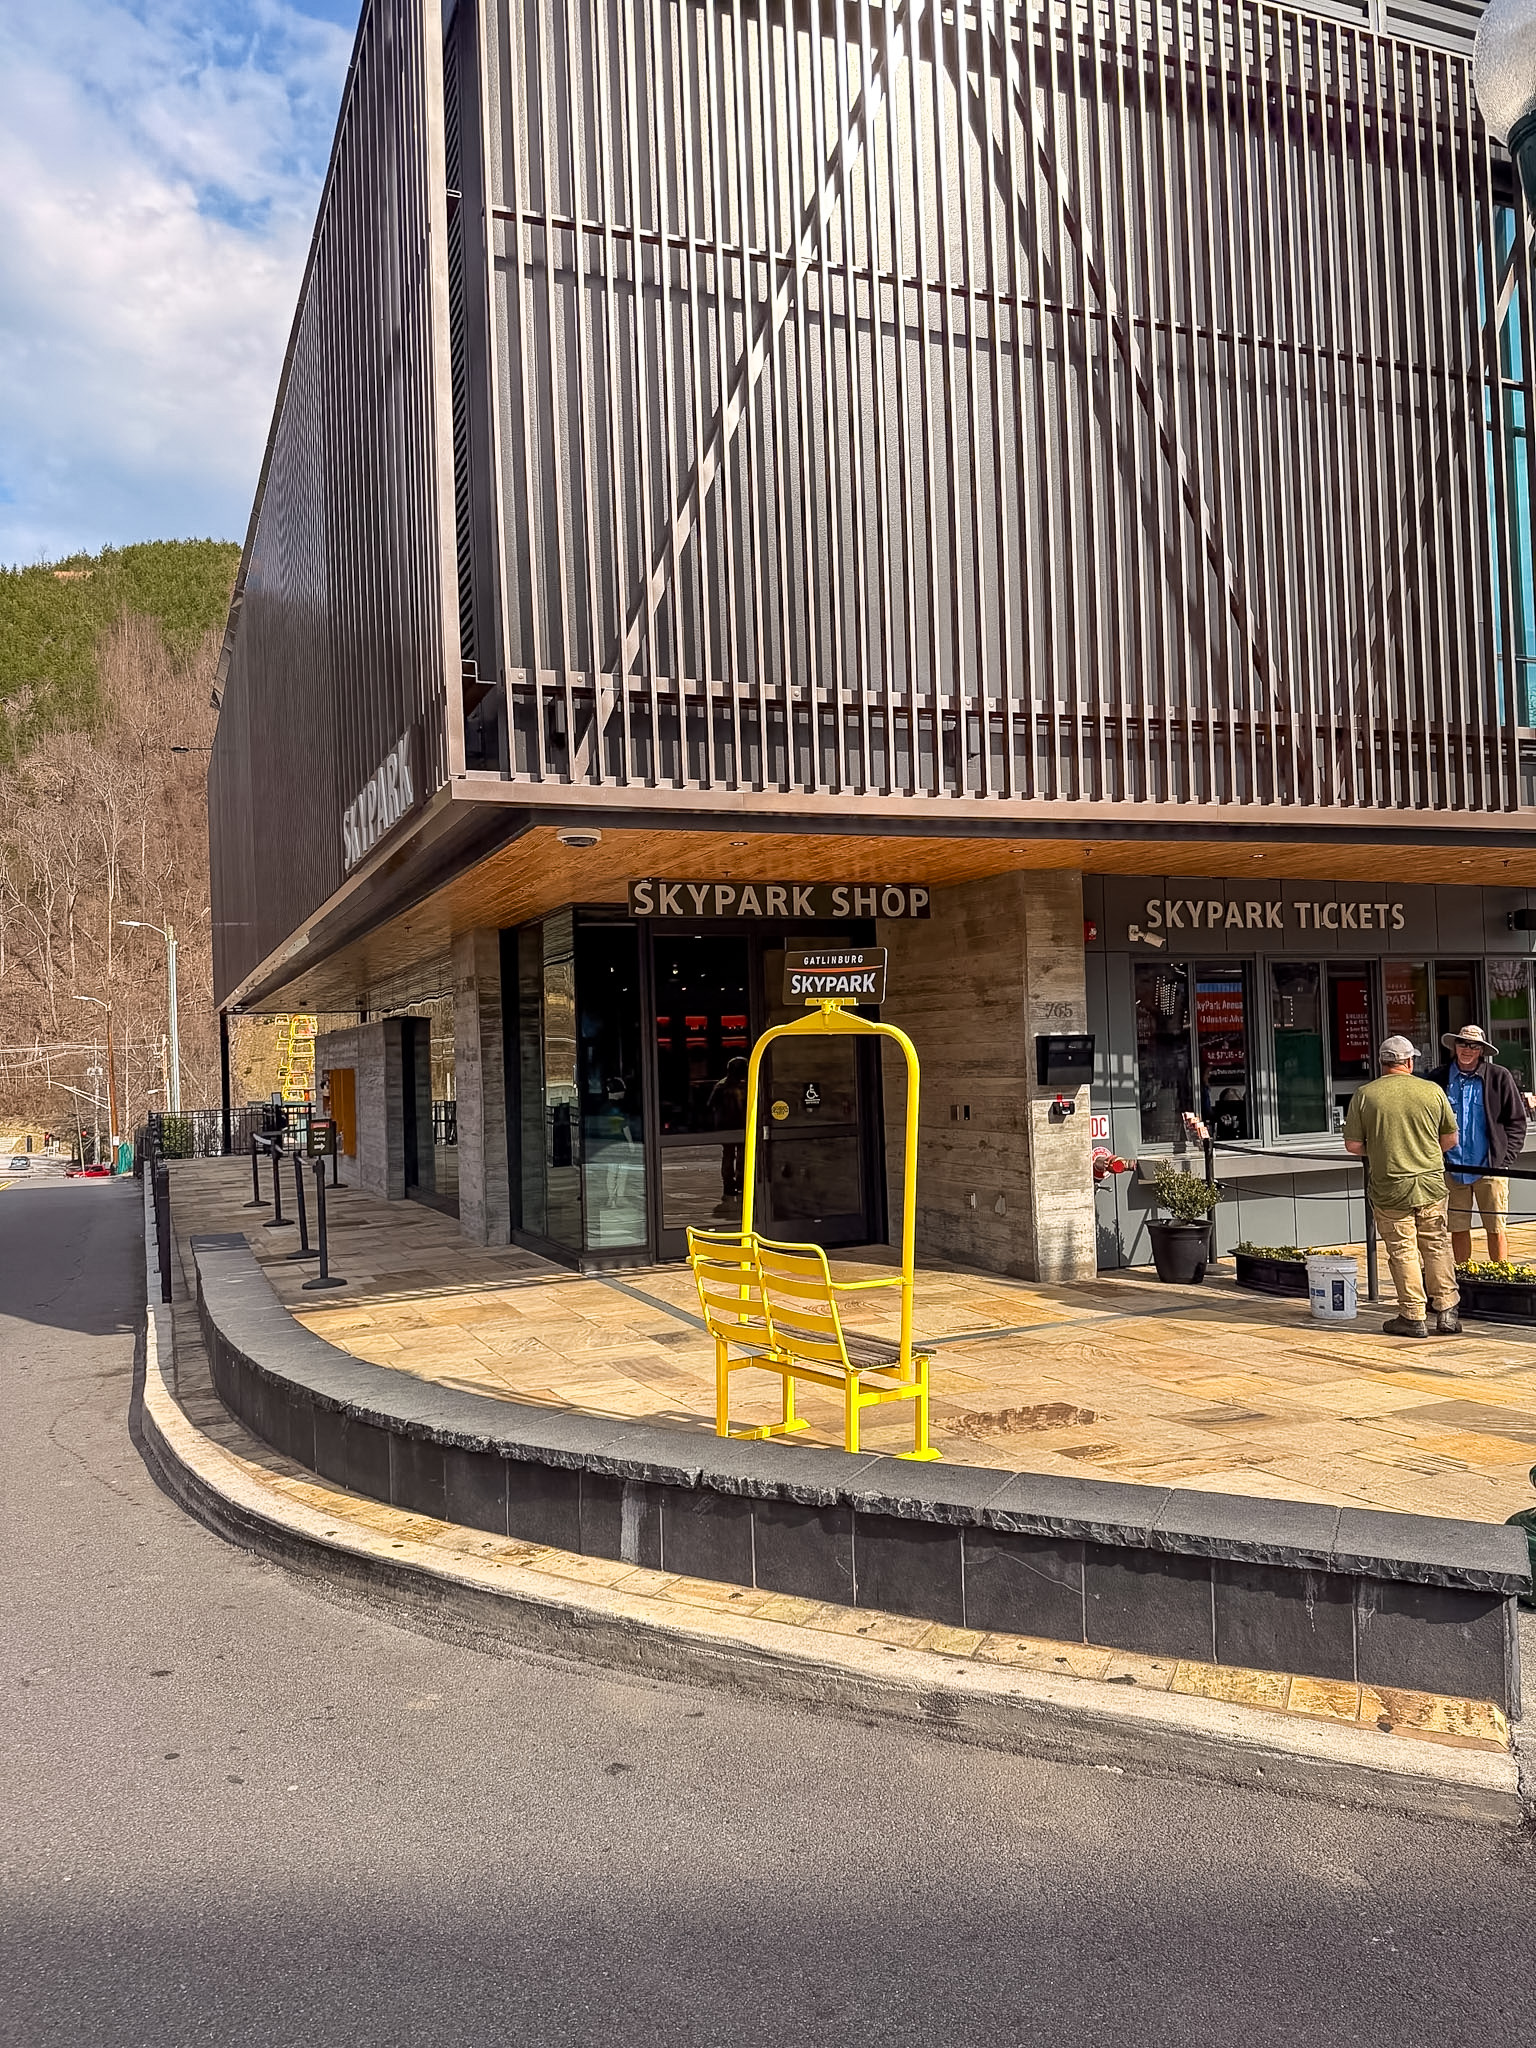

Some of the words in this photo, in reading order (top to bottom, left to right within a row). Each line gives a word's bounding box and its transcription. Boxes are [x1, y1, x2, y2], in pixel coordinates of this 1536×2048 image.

[343, 730, 414, 871] SKYPARK
[633, 882, 816, 916] SKYPARK
[831, 886, 929, 918] SHOP
[1146, 899, 1284, 929] SKYPARK
[1293, 901, 1406, 930] TICKETS
[803, 955, 864, 966] GATLINBURG
[790, 972, 877, 995] SKYPARK
[1045, 1002, 1074, 1018] 765
